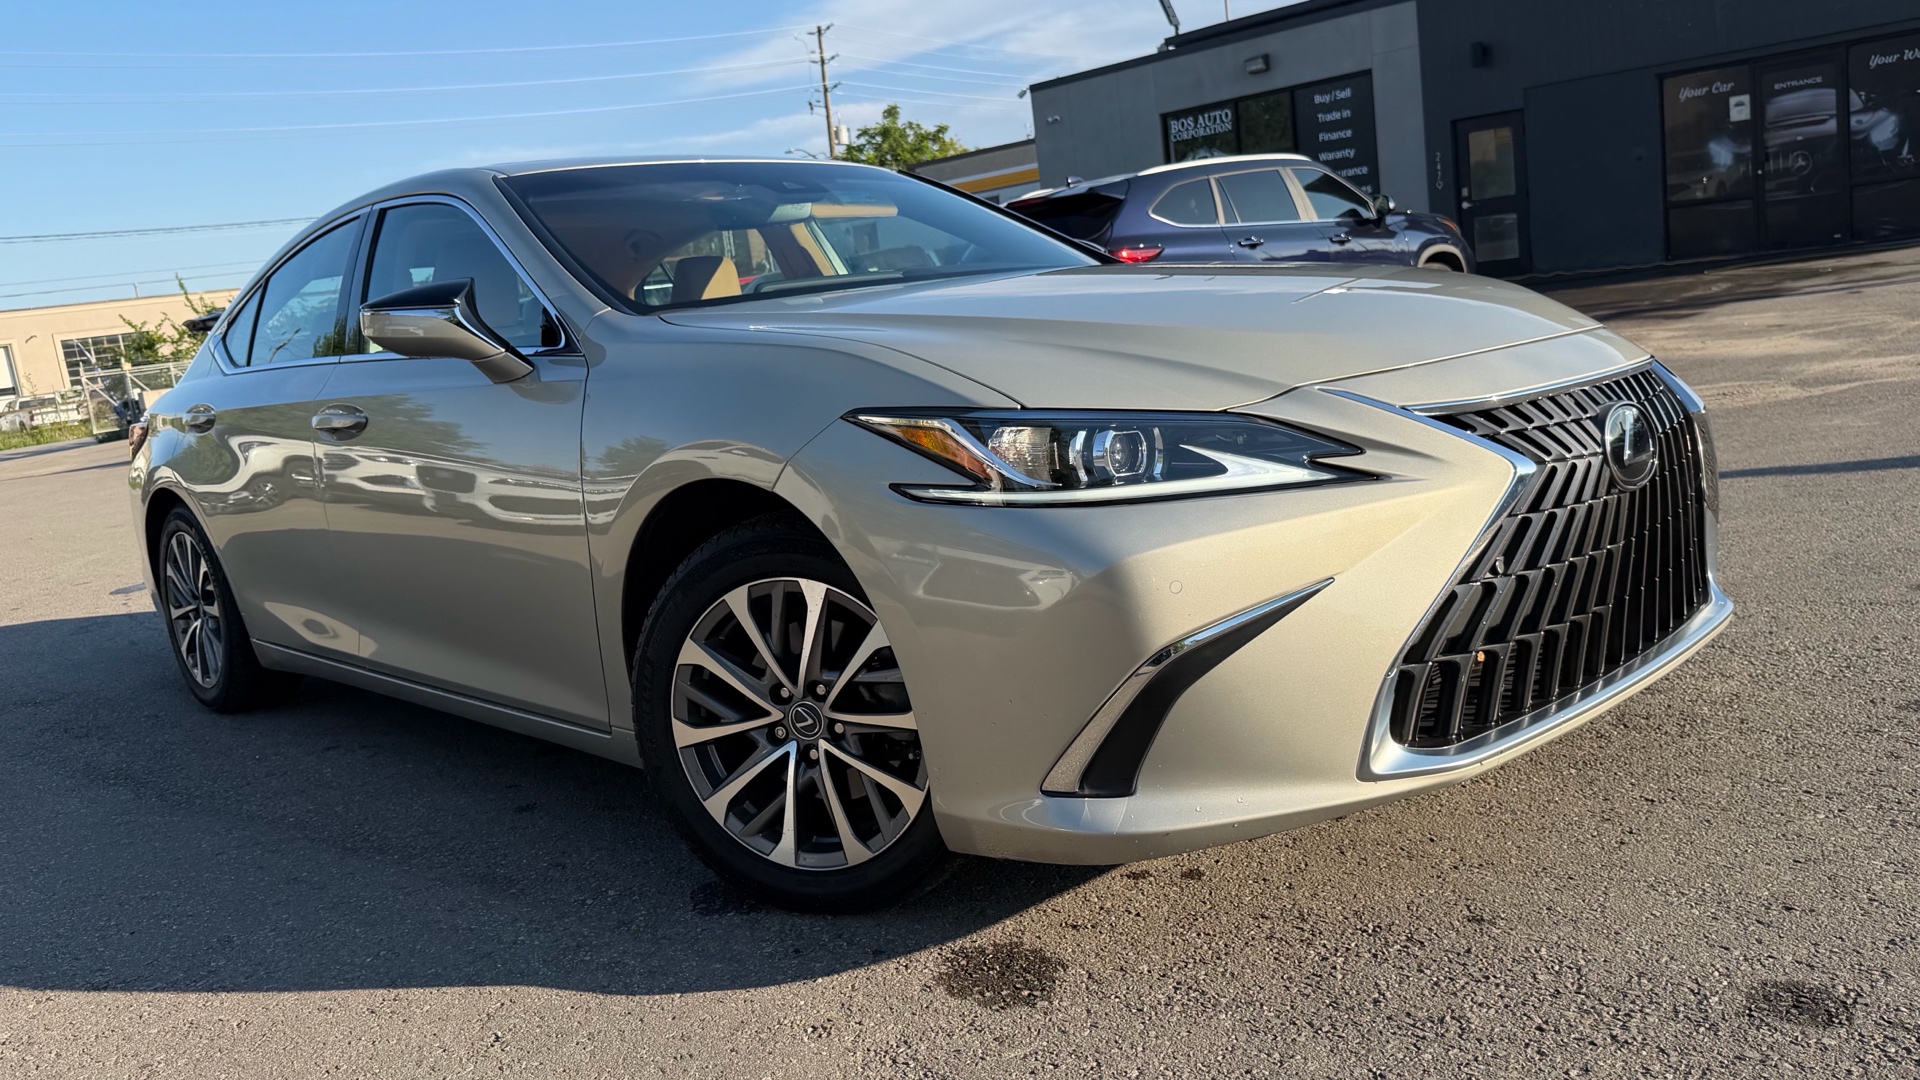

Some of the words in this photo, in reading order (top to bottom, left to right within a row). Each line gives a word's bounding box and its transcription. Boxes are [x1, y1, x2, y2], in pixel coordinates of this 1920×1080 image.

[1869, 54, 1900, 70] Your
[1774, 76, 1824, 90] ENTRANCE
[1679, 86, 1709, 102] Your
[1712, 81, 1735, 94] Car
[1170, 116, 1195, 134] BOS
[1197, 109, 1232, 128] AUTO
[1317, 111, 1341, 123] Trade
[1171, 121, 1232, 142] CORPORATION
[1319, 130, 1352, 142] Finance
